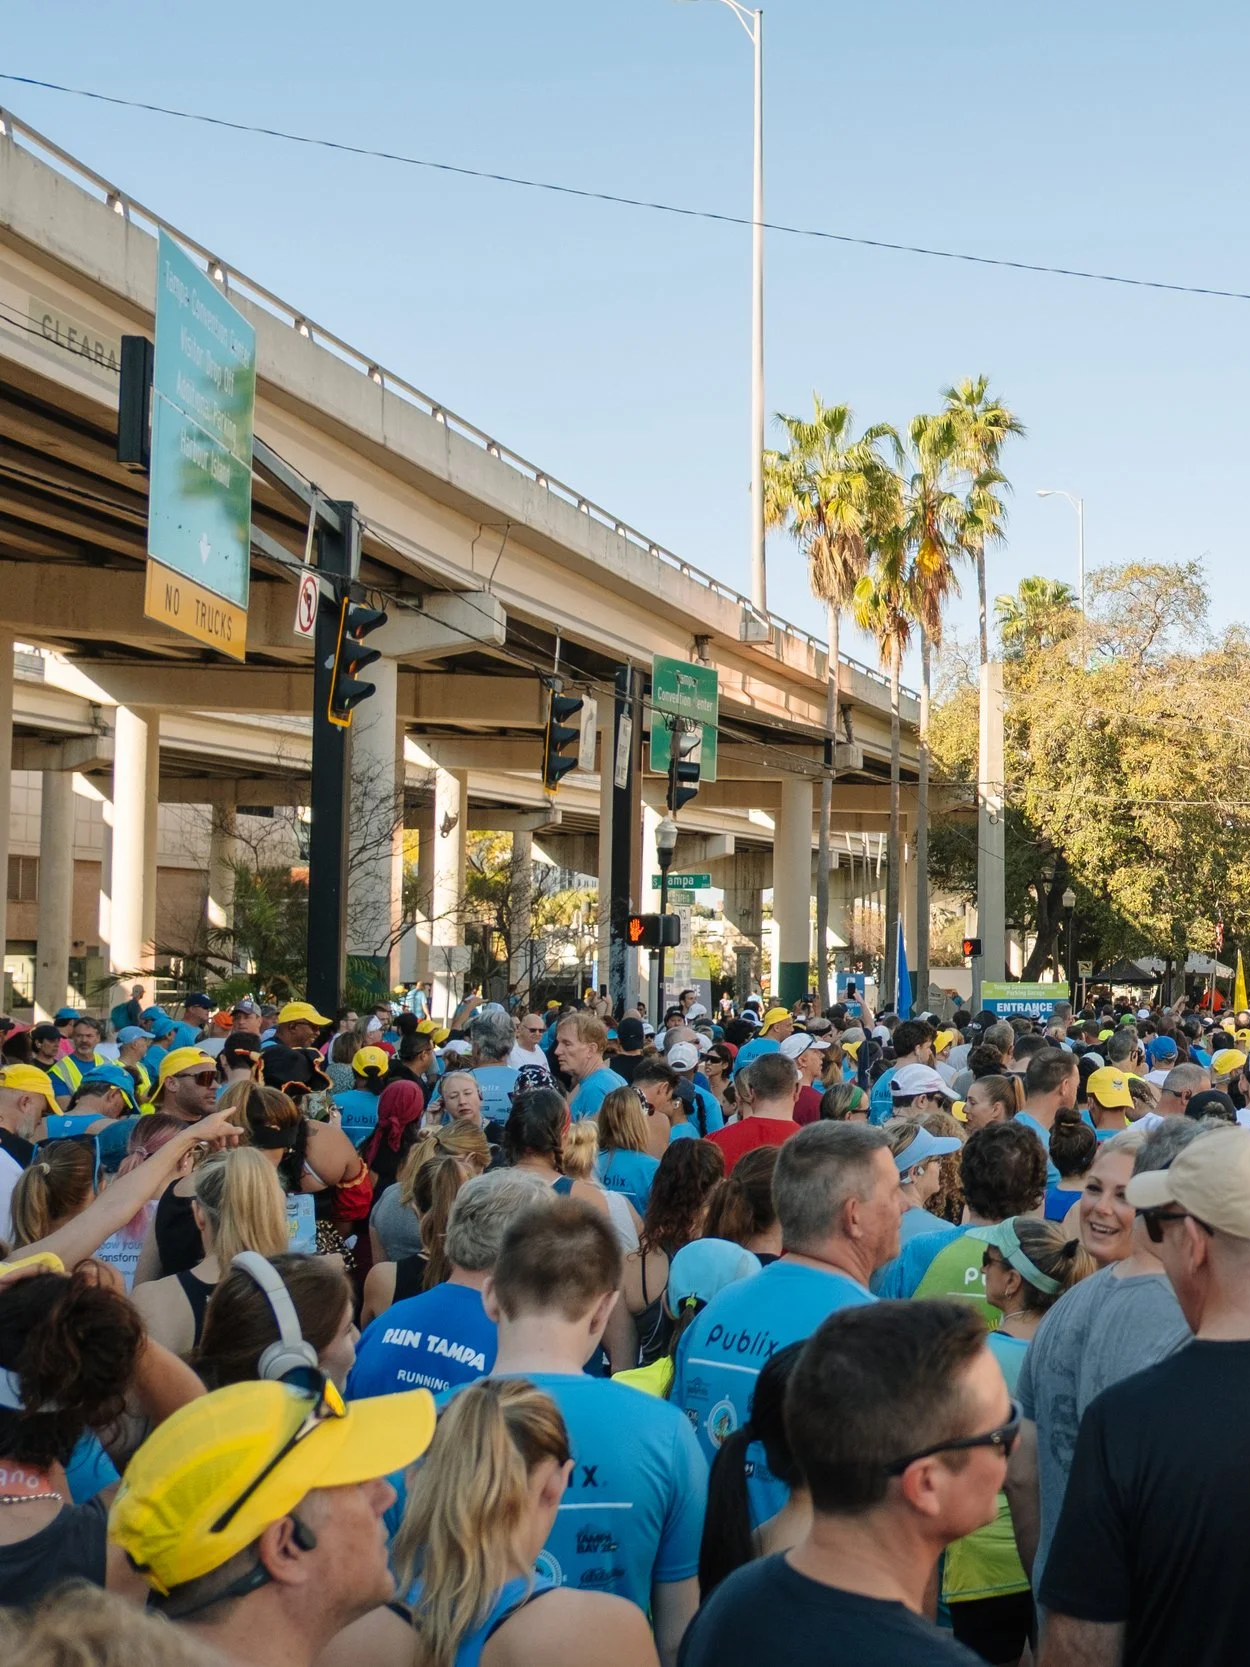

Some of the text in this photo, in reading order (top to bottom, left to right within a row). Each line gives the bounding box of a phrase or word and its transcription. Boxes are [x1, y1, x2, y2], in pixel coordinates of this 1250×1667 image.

[42, 314, 118, 376] CLEARA
[165, 583, 232, 641] NO TRUCKS
[667, 877, 694, 888] ampa
[997, 1002, 1053, 1012] ENTRANCE
[603, 1175, 626, 1187] blix
[382, 1328, 486, 1372] RUN TAMPA
[705, 1324, 779, 1358] Publix
[397, 1369, 450, 1392] RUNNING
